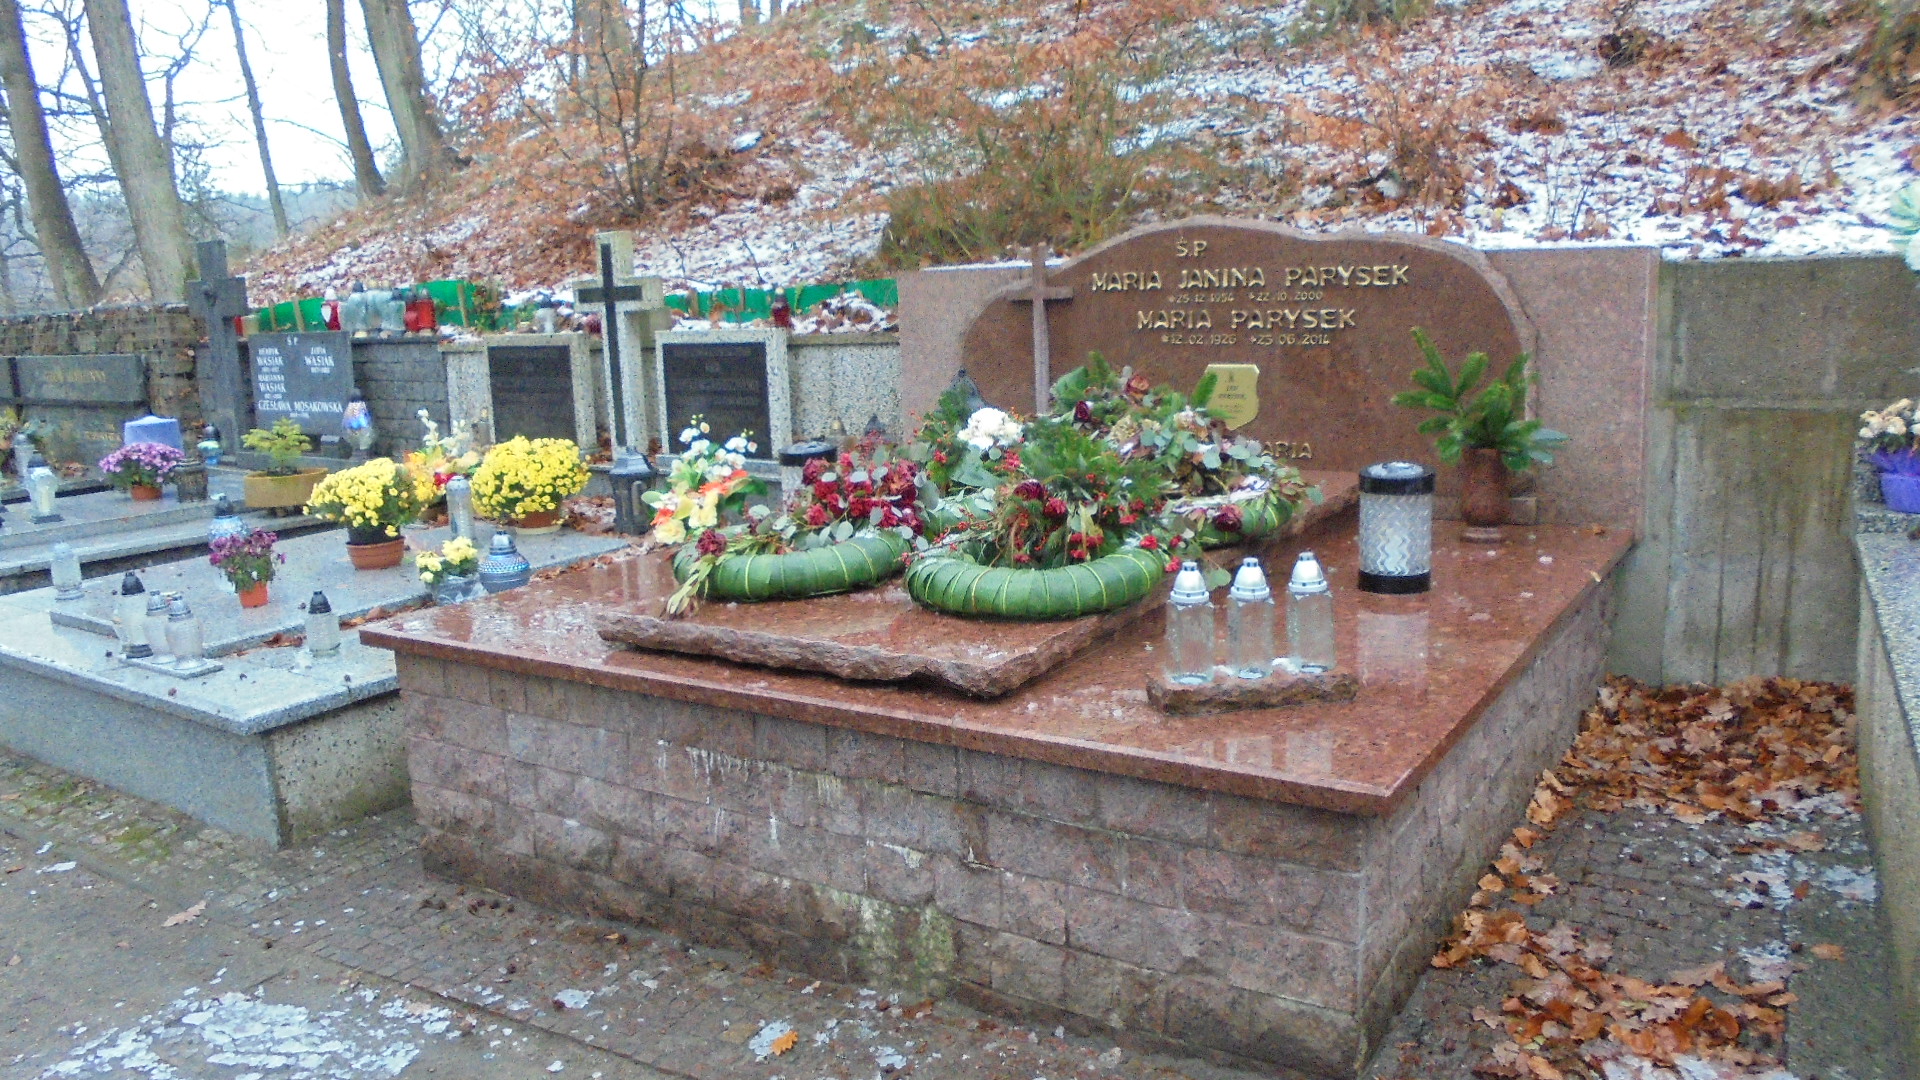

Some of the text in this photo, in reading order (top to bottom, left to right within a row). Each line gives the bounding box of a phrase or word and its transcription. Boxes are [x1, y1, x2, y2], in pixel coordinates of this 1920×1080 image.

[1091, 264, 1409, 292] MARIA JANINA PARYSEK
[1137, 307, 1356, 330] MARIA PARYSEK
[304, 355, 335, 367] WASIAK
[258, 382, 287, 393] WASIAK
[1258, 441, 1313, 459] ARIA
